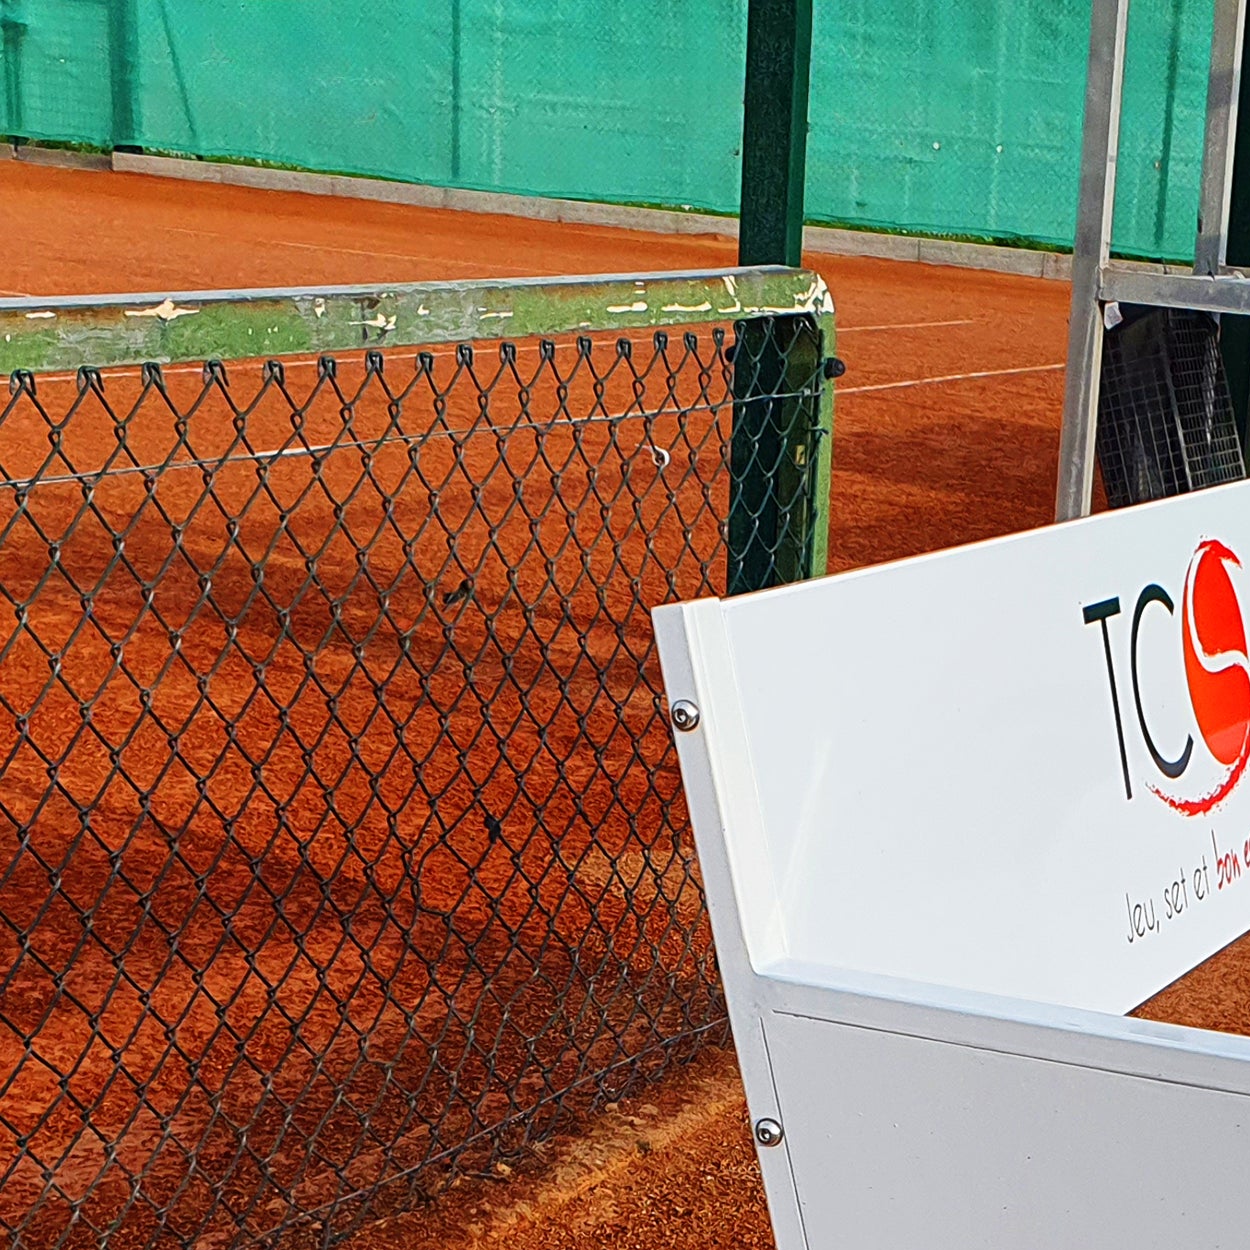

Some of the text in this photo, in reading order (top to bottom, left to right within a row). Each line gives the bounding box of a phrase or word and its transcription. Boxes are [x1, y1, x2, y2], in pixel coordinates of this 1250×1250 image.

[1125, 892, 1160, 943] Jeu,
[1164, 867, 1188, 910] set
[1193, 855, 1210, 901] et
[1211, 828, 1241, 890] bon
